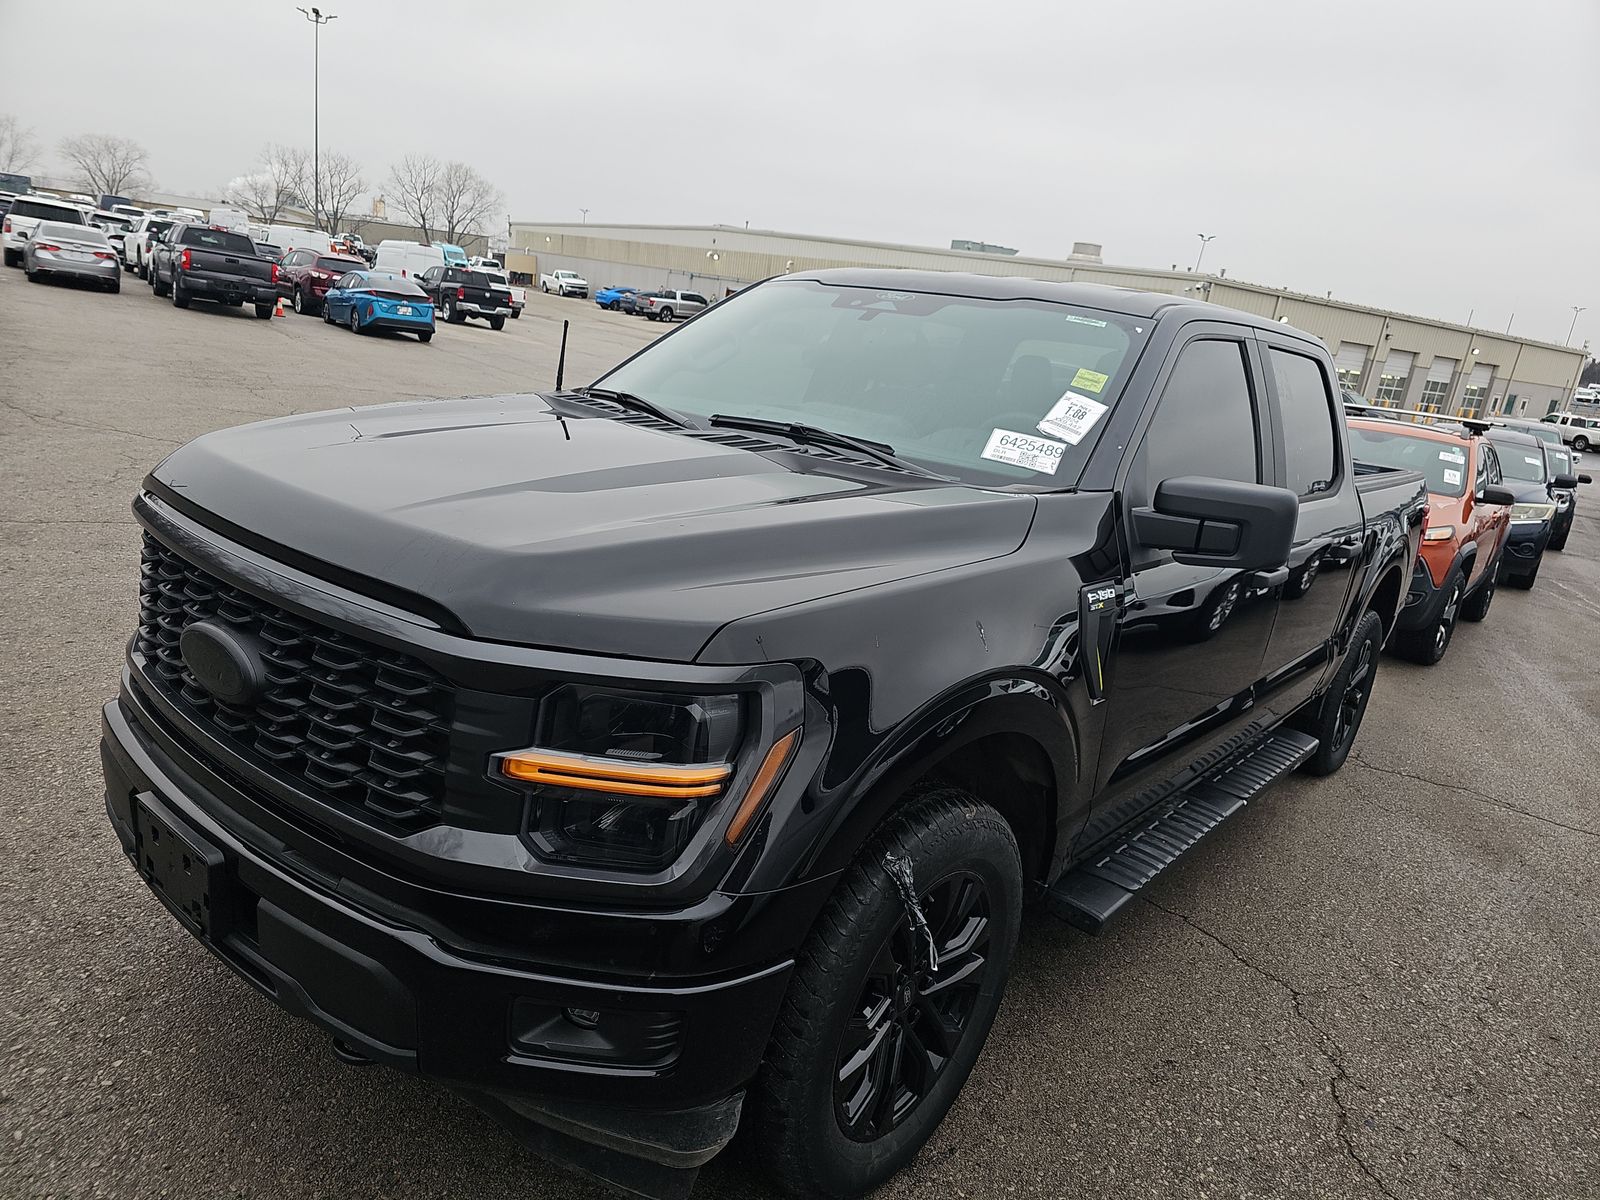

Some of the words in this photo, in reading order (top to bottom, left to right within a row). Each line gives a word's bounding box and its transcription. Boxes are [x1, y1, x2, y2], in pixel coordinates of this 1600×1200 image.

[1064, 405, 1088, 421] 1:08
[999, 434, 1064, 459] 6425489
[1087, 588, 1115, 604] F-150
